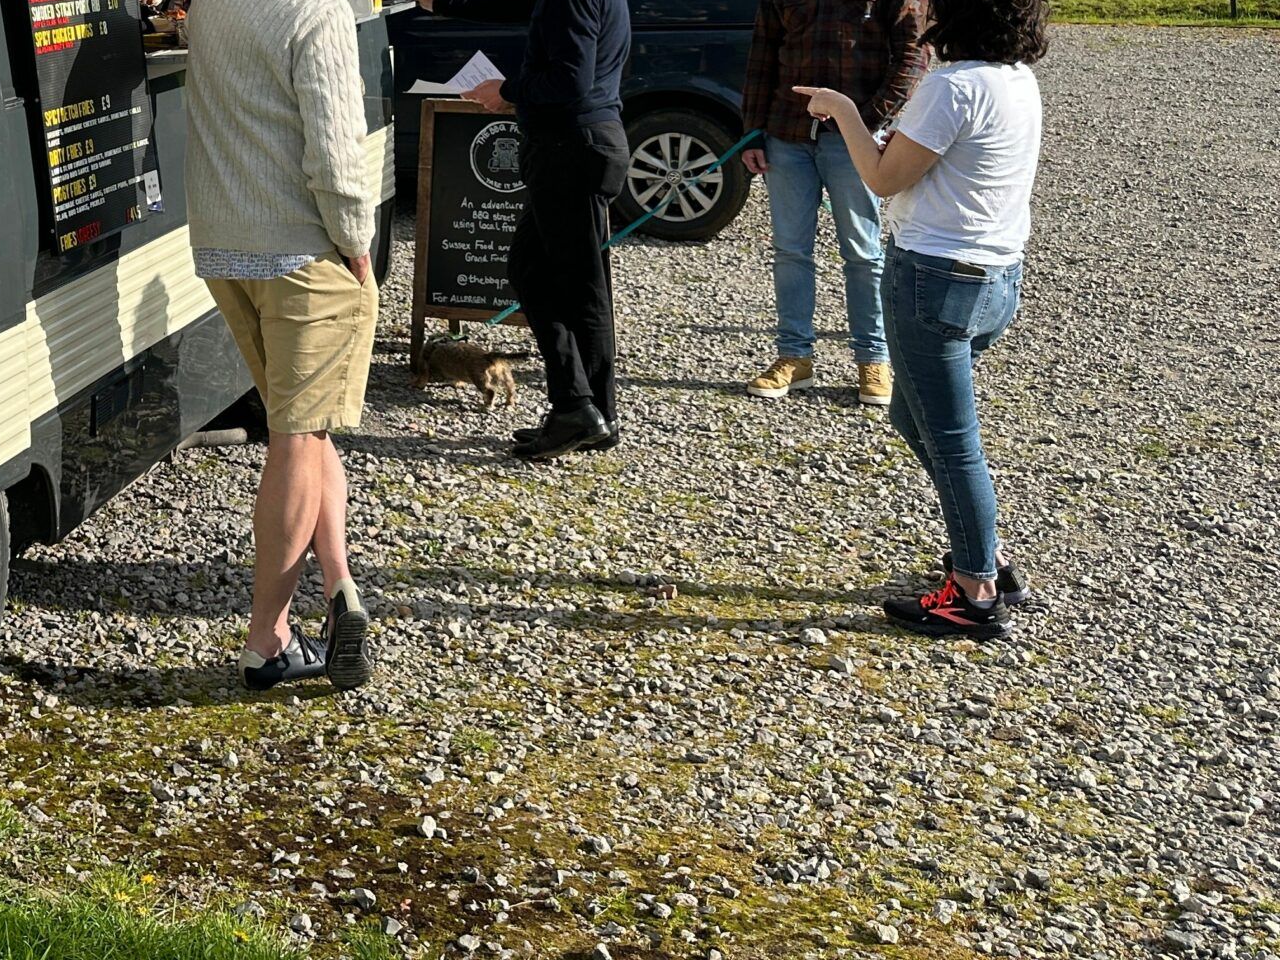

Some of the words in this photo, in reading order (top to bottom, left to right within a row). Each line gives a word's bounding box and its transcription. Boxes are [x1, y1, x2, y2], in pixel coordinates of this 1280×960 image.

[31, 5, 55, 21] SMOKED
[56, 2, 75, 18] STICKY
[76, 0, 90, 15] PORK
[34, 30, 51, 48] SPICY
[52, 26, 75, 44] CHICKEN
[76, 23, 94, 40] WINGS
[99, 21, 108, 35] £8
[44, 108, 60, 127] SPICY
[79, 100, 95, 117] FRIES
[101, 94, 111, 111] £9
[476, 130, 490, 145] THE
[489, 124, 506, 135] BBQ
[510, 125, 521, 134] PA
[49, 148, 65, 167] DIRTY
[66, 142, 82, 160] FRIES
[85, 139, 94, 154] £9
[70, 179, 87, 197] FRIES
[88, 174, 96, 190] £9
[486, 178, 502, 188] TAKE
[512, 180, 524, 189] SLO
[461, 196, 473, 208] An
[481, 200, 524, 210] adventure
[473, 211, 489, 220] BBQ
[453, 219, 474, 234] using
[479, 221, 500, 230] local
[502, 223, 516, 232] fres
[60, 231, 78, 252] FRIES
[442, 239, 470, 250] Sussex
[475, 240, 494, 250] Food
[465, 252, 488, 262] Grand
[450, 294, 487, 304] ALLERGEN
